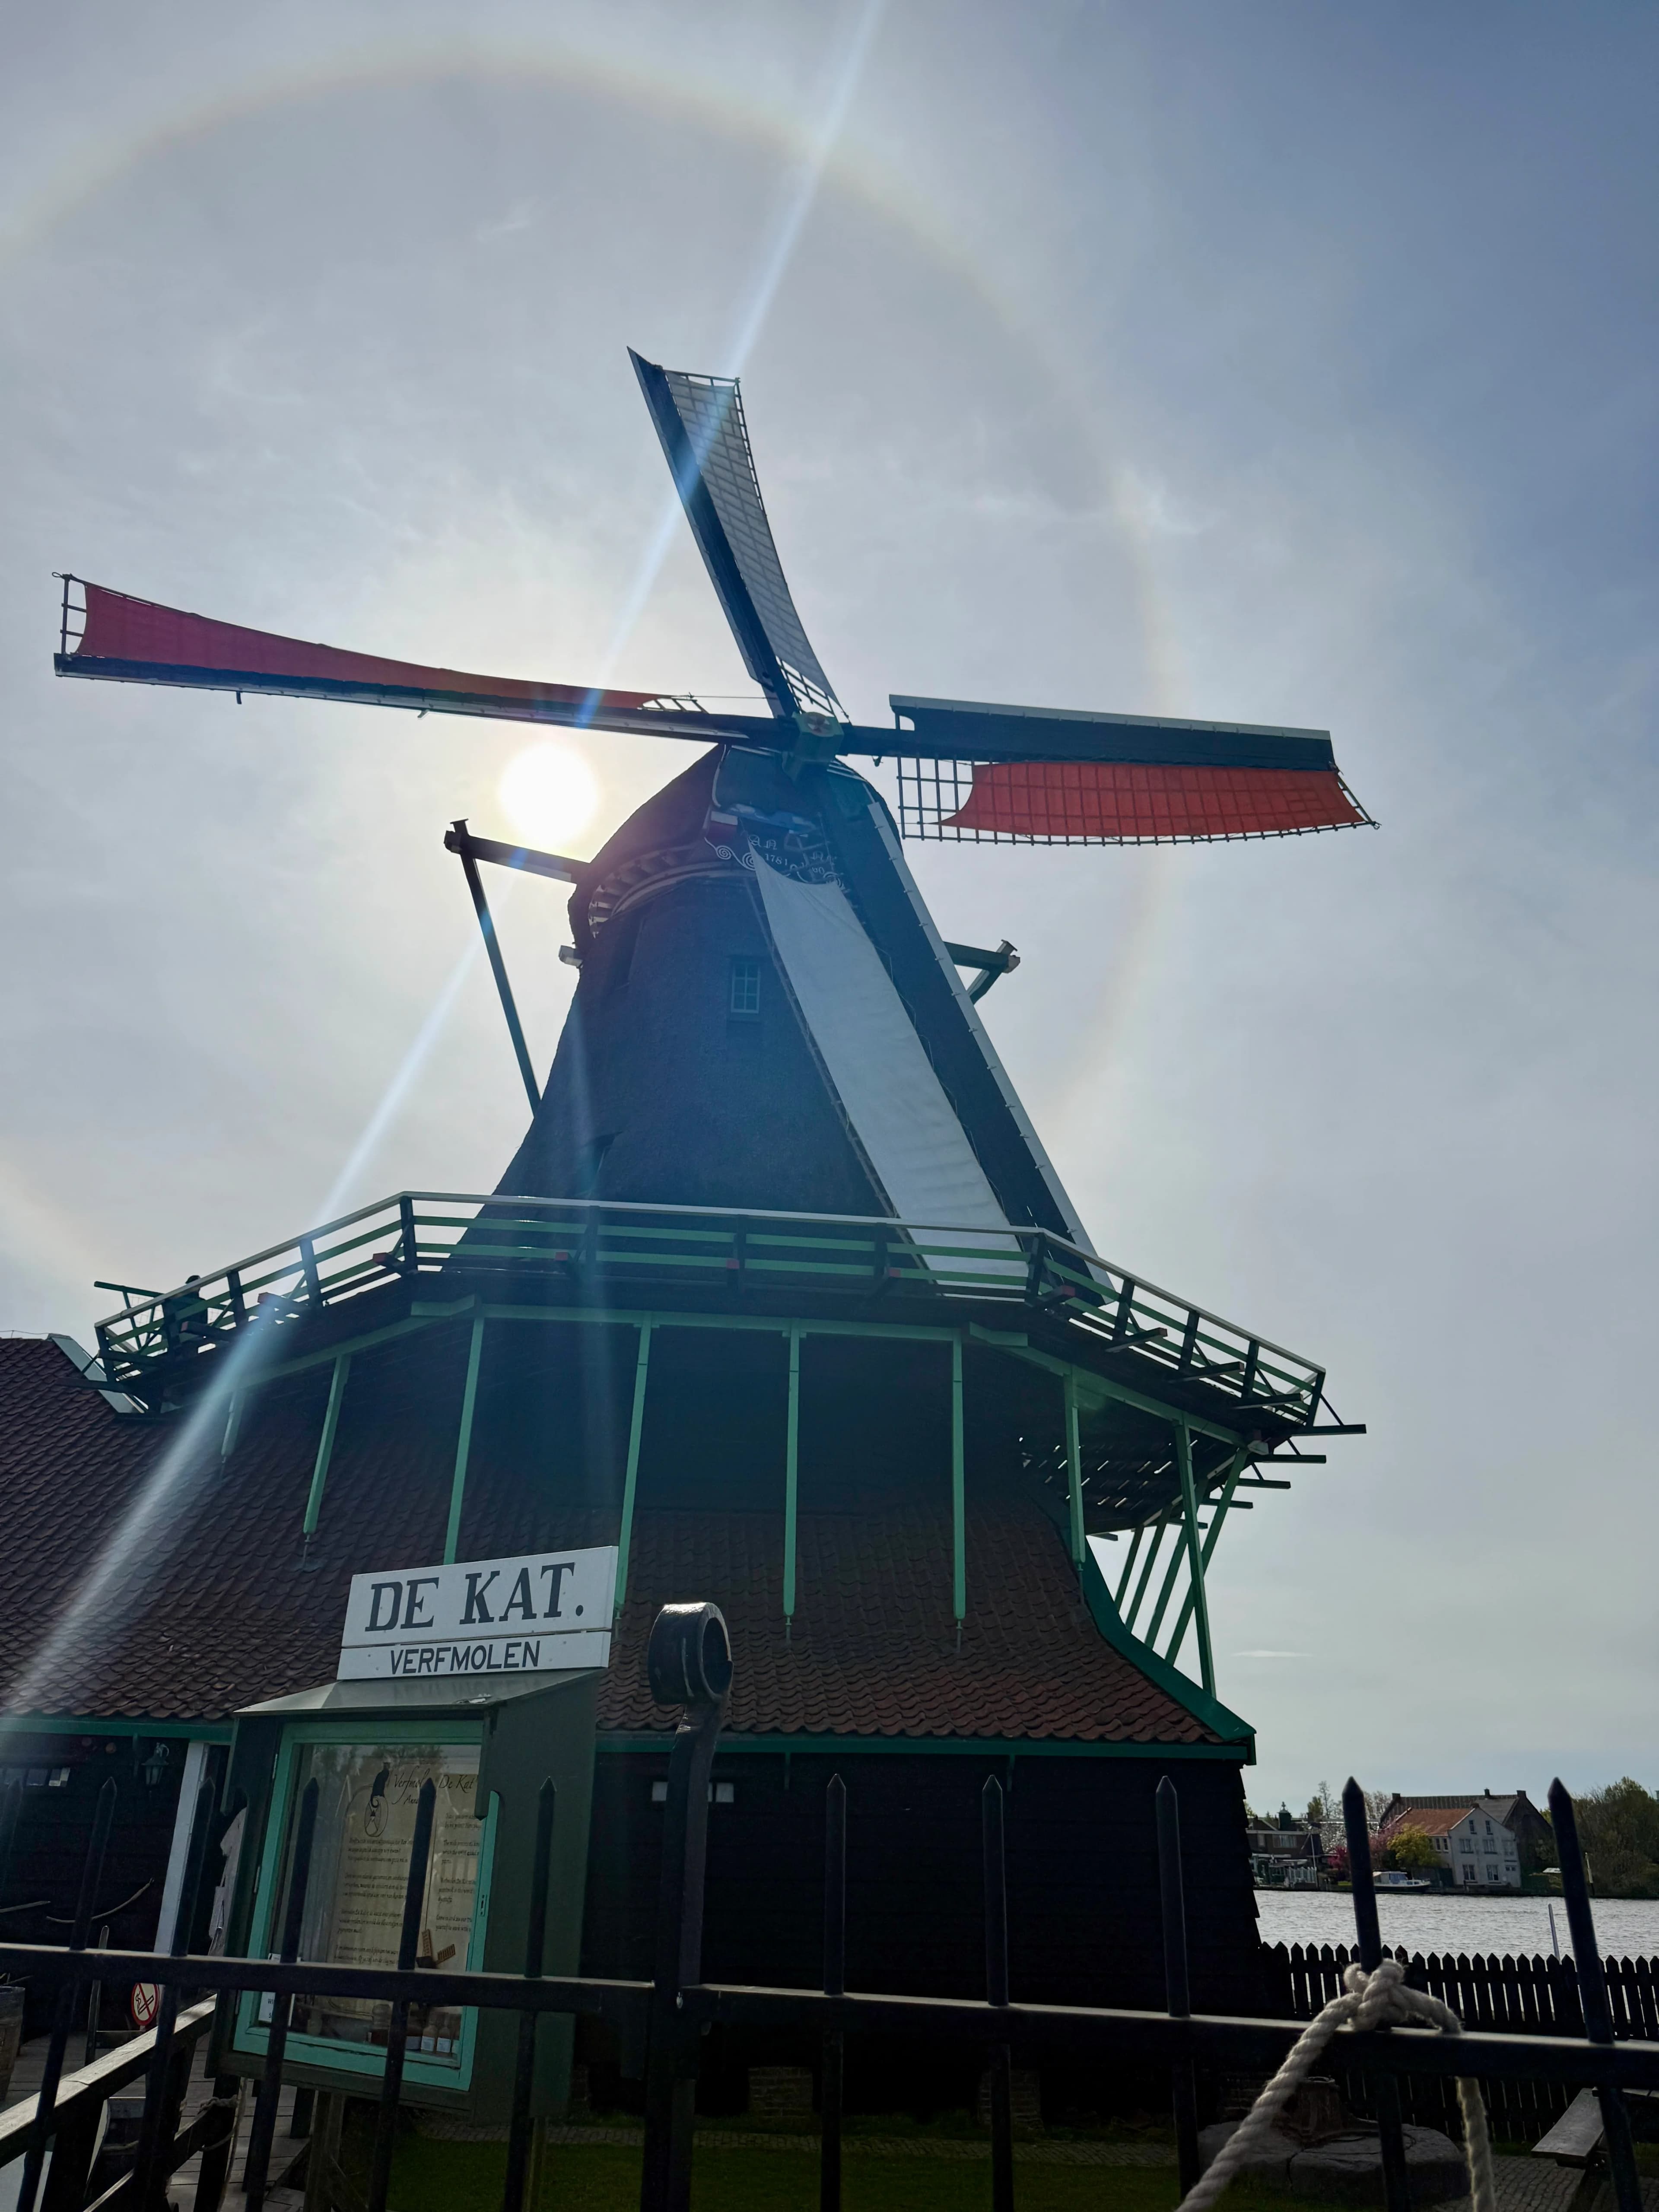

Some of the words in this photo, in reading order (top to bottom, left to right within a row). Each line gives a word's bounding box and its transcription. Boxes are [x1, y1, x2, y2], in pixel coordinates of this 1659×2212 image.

[765, 853, 788, 866] 1781
[365, 1577, 439, 1632] DE
[460, 1562, 584, 1624] KAT.
[390, 1640, 540, 1675] VERFMOLEN
[392, 1766, 430, 1805] Verfmol
